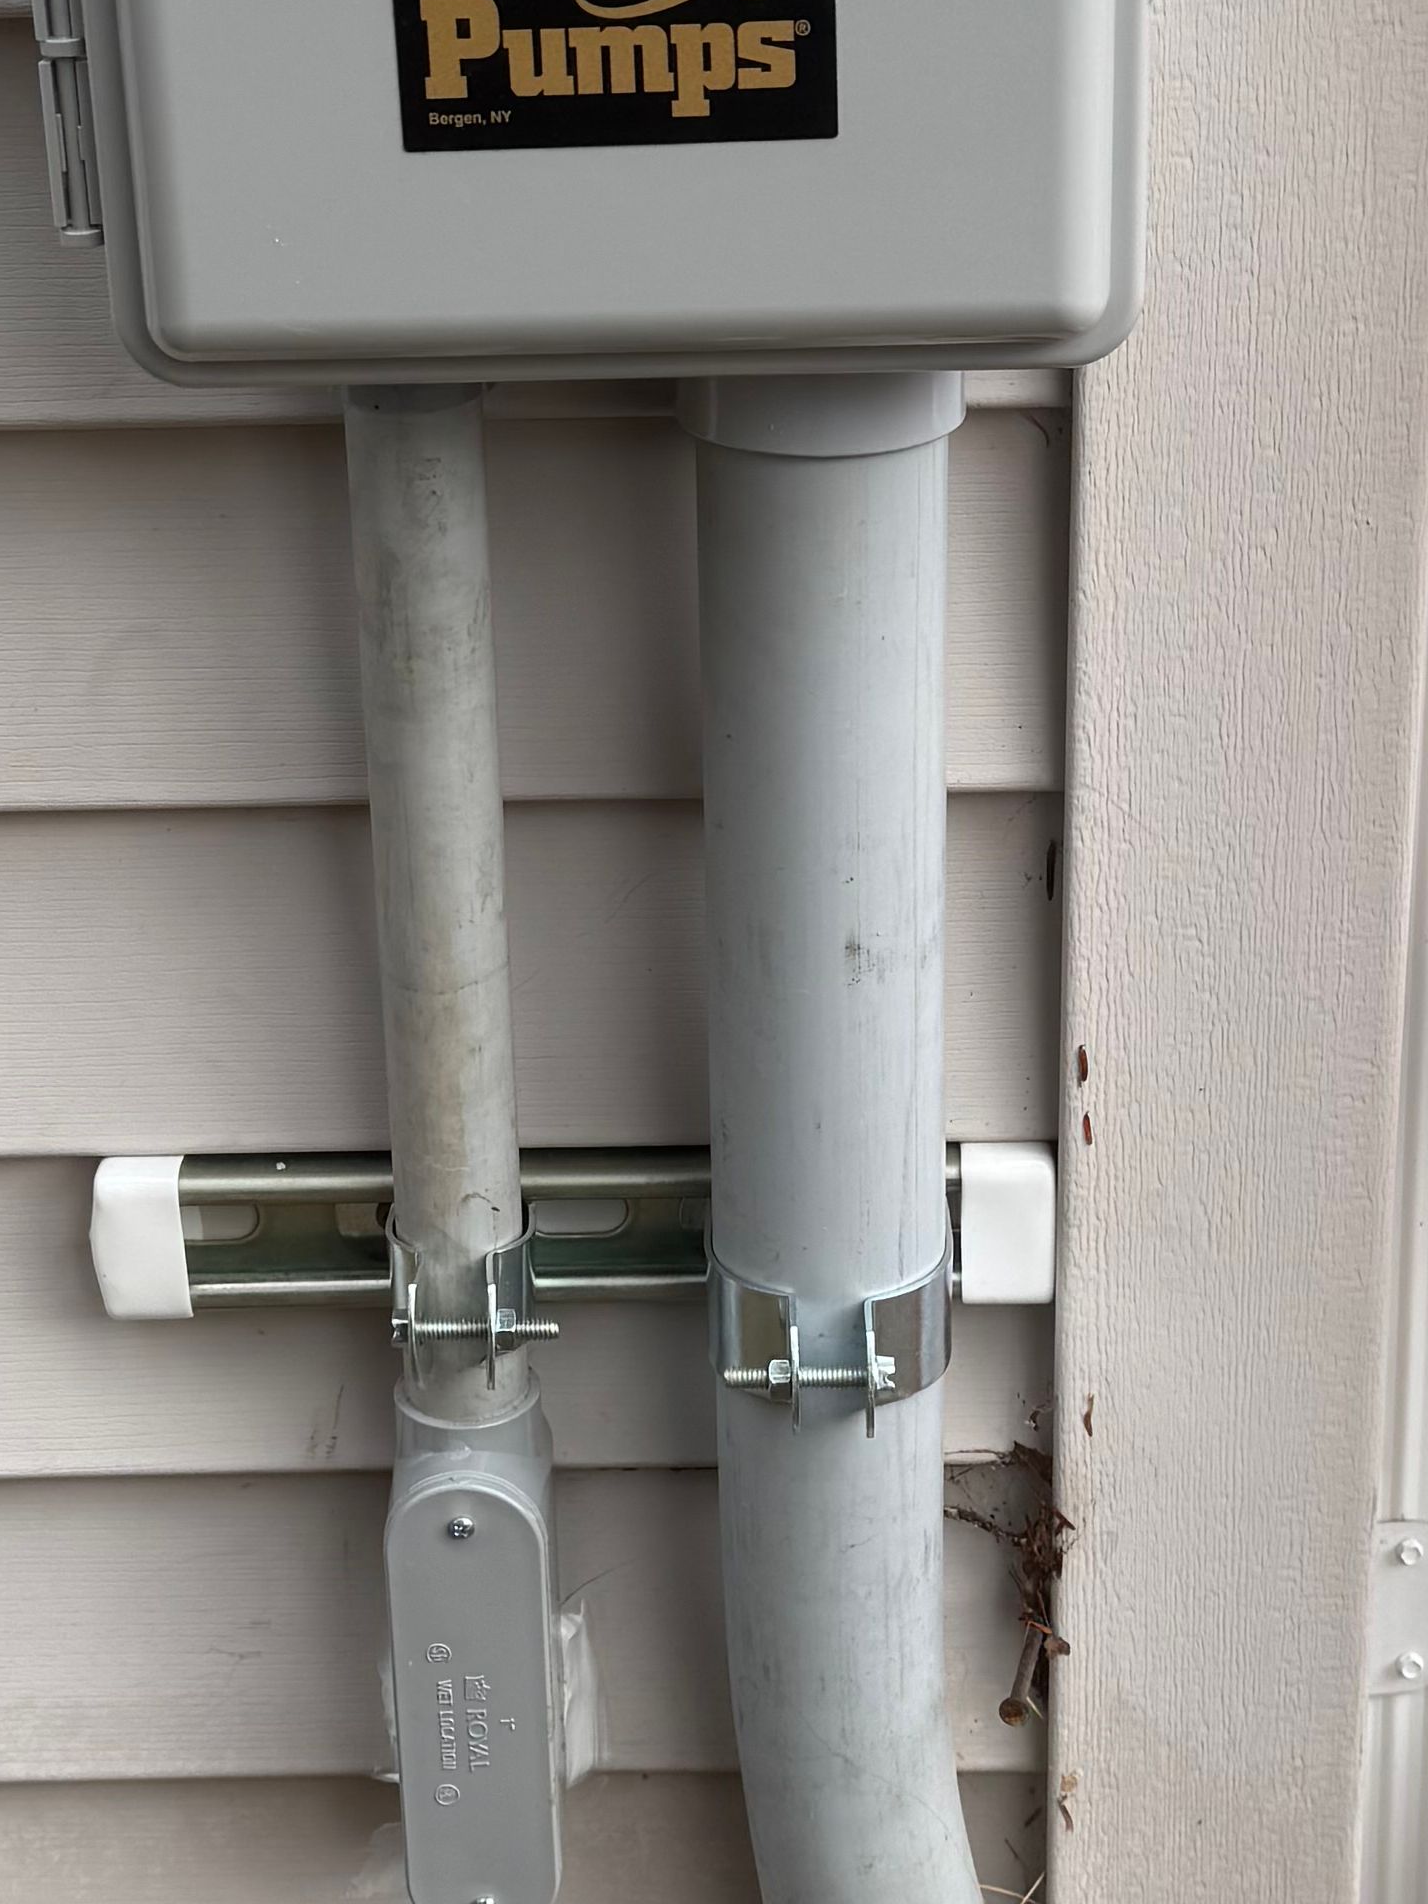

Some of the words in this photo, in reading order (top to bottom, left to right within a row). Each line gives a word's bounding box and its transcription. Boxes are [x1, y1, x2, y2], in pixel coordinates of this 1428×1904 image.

[428, 111, 487, 127] Bergen,
[490, 110, 512, 124] NY
[437, 1679, 453, 1705] WET
[438, 1710, 457, 1770] LOCATION
[466, 1708, 490, 1773] ROYAL
